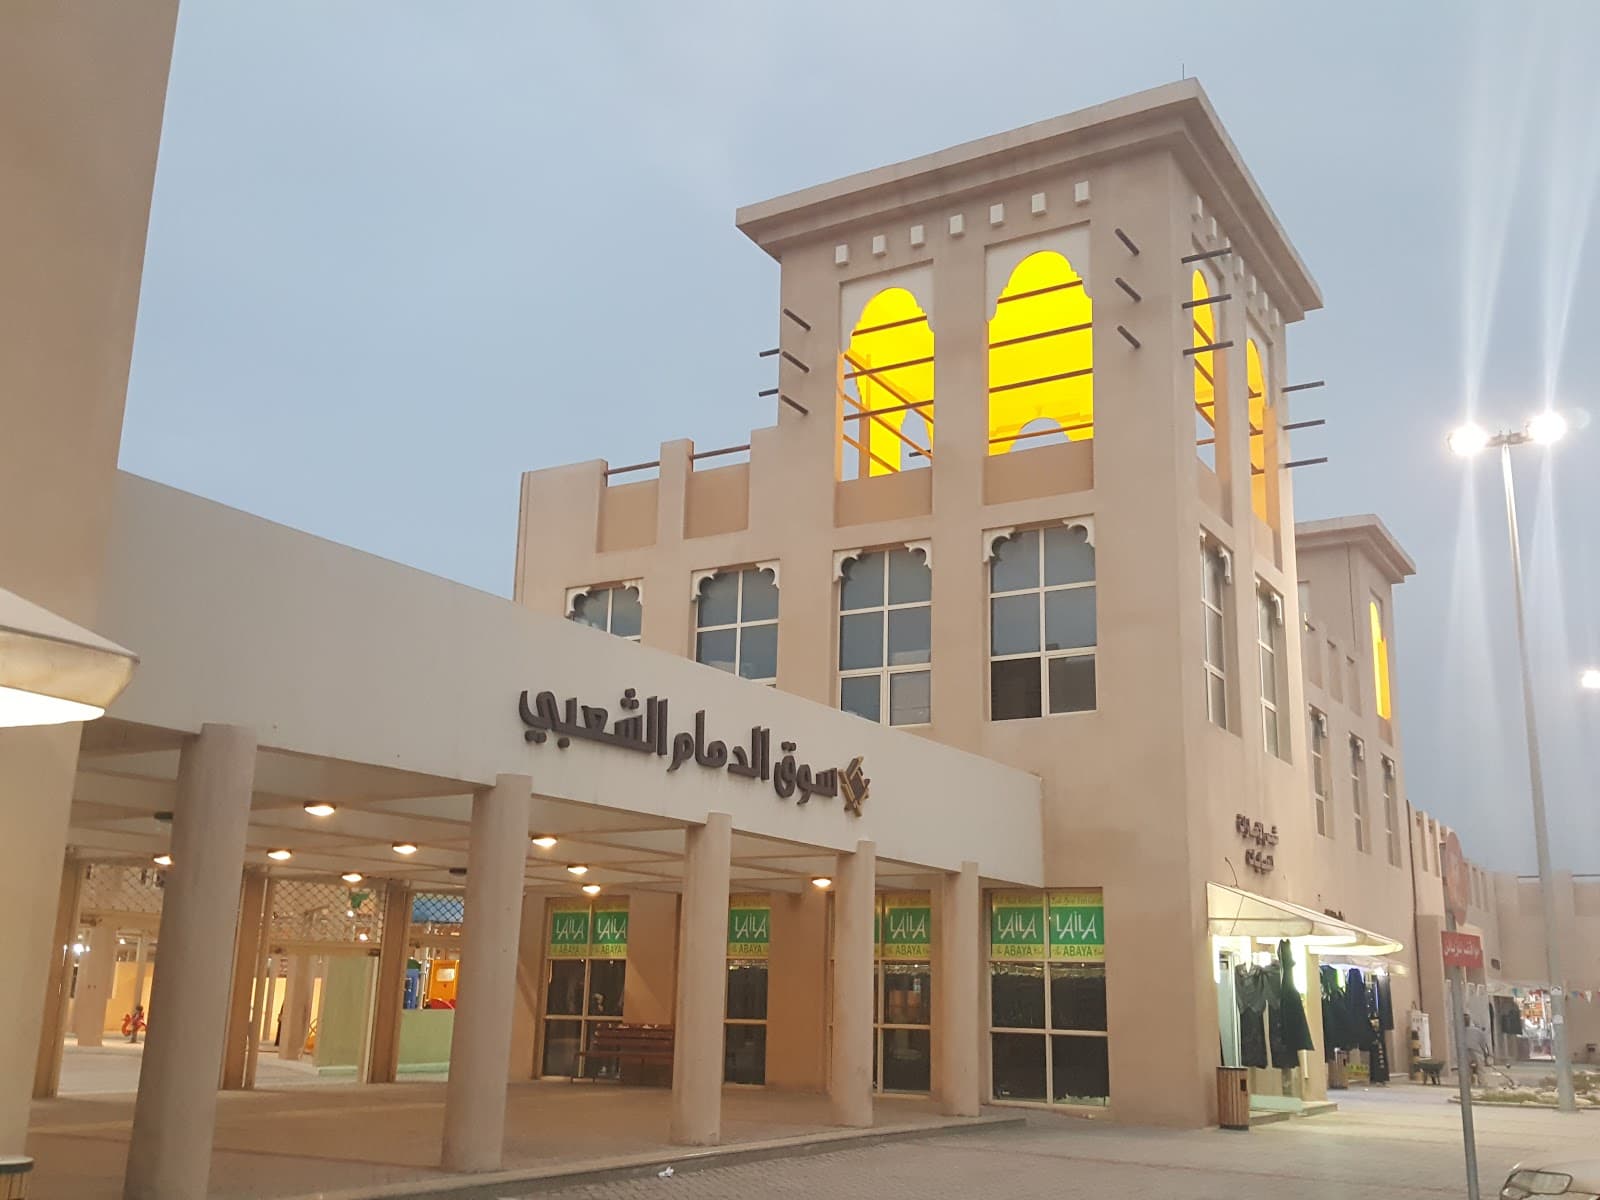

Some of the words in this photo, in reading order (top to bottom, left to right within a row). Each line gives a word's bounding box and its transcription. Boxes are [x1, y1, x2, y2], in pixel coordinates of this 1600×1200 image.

[519, 687, 668, 756] الشعبي
[667, 710, 770, 780] الدمام
[774, 741, 837, 806] سوق
[896, 944, 921, 955] ABAYA
[1004, 945, 1033, 956] ABAYA
[1063, 945, 1092, 957] ABAYA
